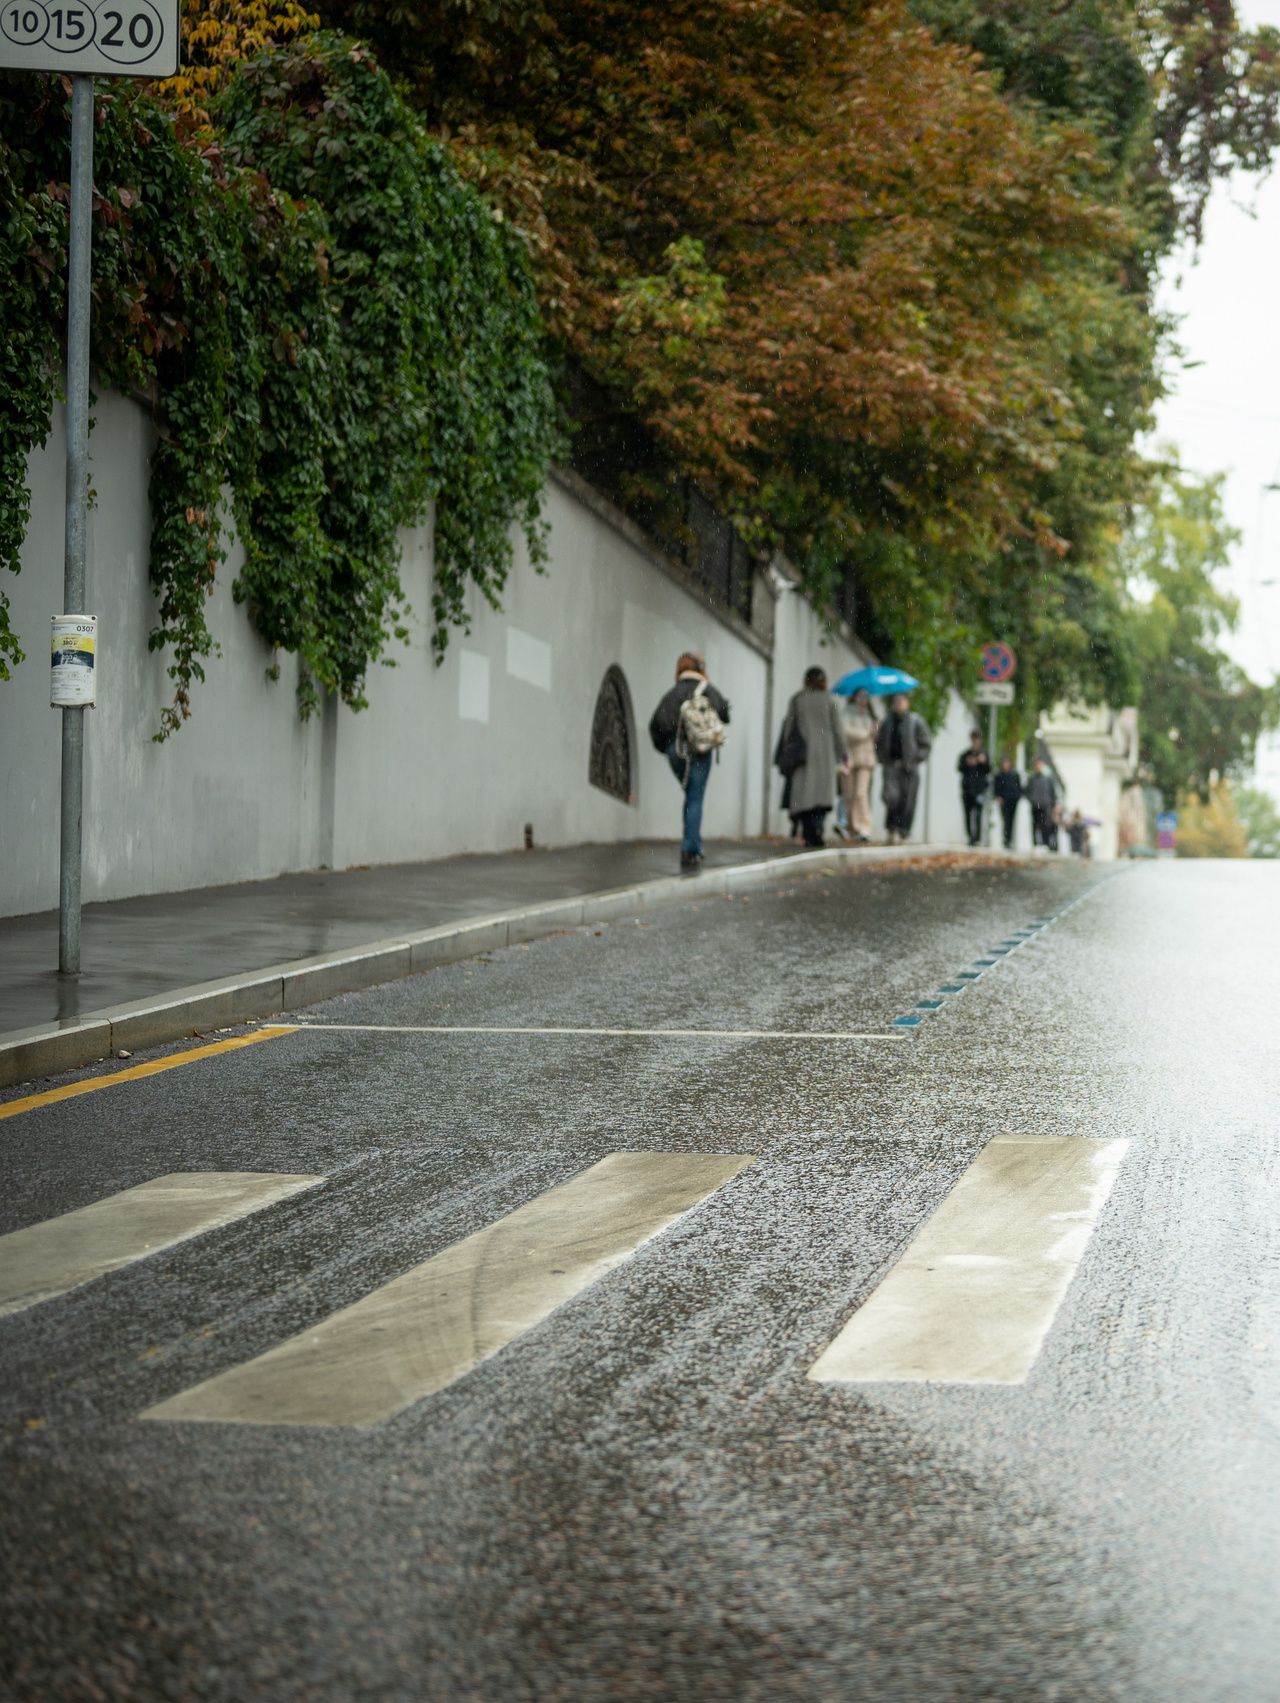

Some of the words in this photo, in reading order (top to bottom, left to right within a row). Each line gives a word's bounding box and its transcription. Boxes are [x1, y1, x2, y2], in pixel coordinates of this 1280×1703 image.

[9, 9, 39, 33] 10
[50, 9, 85, 41] 15
[100, 11, 154, 49] 20
[76, 625, 94, 633] 0307
